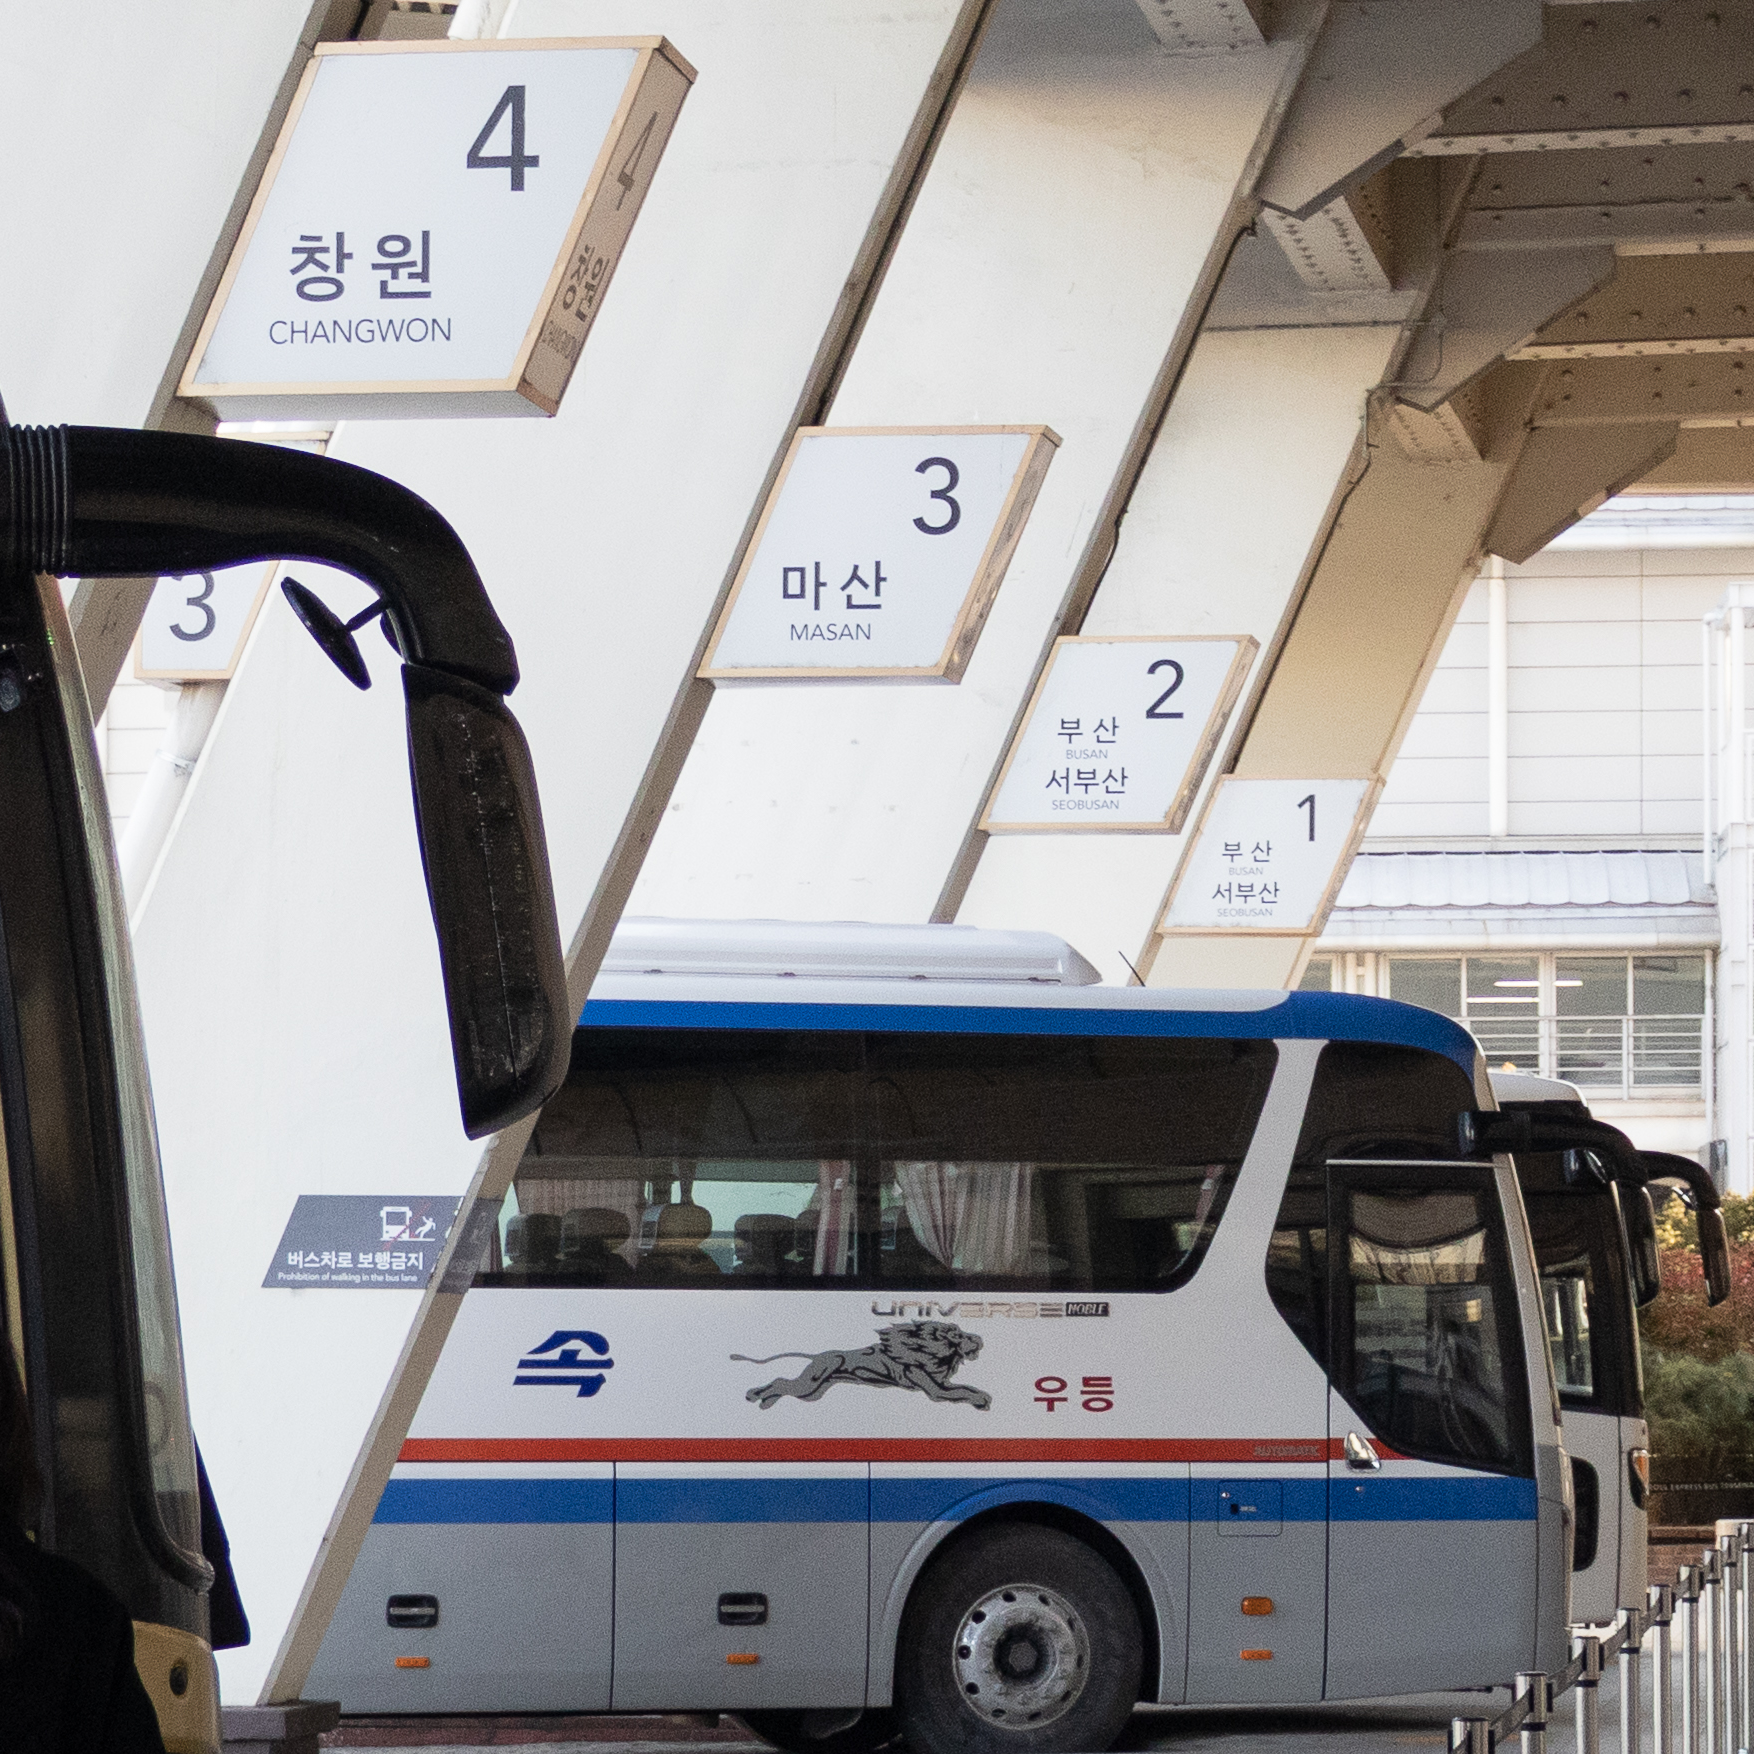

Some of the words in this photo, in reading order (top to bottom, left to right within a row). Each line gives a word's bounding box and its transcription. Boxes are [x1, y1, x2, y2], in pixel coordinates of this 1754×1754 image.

[466, 84, 540, 192] 4
[288, 230, 433, 302] 창원
[268, 317, 452, 346] CHANGWON
[911, 456, 962, 535] 3
[782, 560, 888, 612] 마산
[168, 571, 217, 642] 3
[789, 622, 872, 642] MASAN
[1145, 659, 1185, 720] 2
[1057, 716, 1120, 744] 부산
[1065, 749, 1109, 760] BUSAN
[1045, 766, 1129, 795] 서부산
[1051, 799, 1120, 811] SEOBUSAN
[1296, 793, 1318, 842] 1
[1221, 840, 1274, 864] 부산
[1228, 866, 1264, 876] BUSAN
[1211, 881, 1280, 905] 서부산
[1216, 907, 1274, 918] SEOBUSAN
[287, 1251, 354, 1270] 버스차로
[357, 1251, 424, 1270] 보행금지
[277, 1271, 320, 1282] Prohibition
[321, 1272, 330, 1282] of
[331, 1272, 361, 1284] walking
[370, 1273, 384, 1283] the
[385, 1273, 399, 1283] bus
[400, 1273, 418, 1283] lane
[1033, 1376, 1115, 1413] 우등
